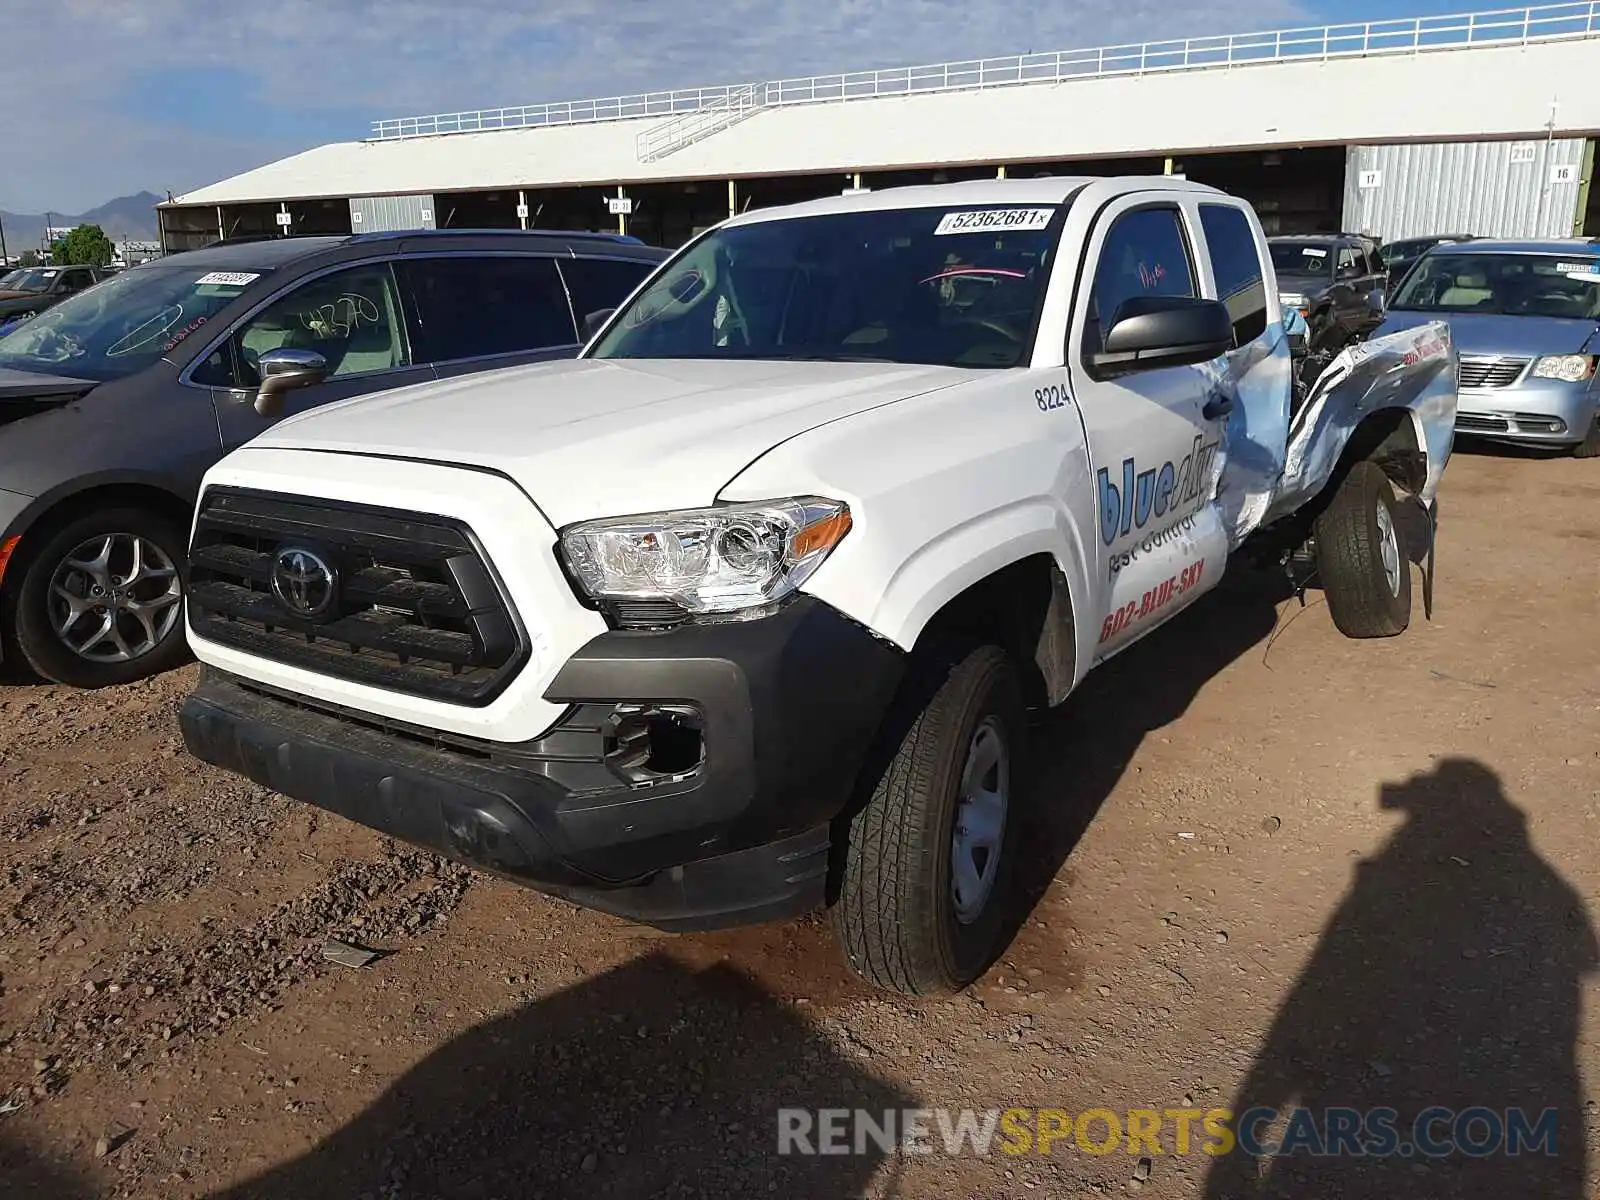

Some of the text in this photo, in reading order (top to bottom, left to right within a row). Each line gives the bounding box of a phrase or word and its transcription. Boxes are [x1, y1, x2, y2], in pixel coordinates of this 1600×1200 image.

[1367, 174, 1375, 184] 17
[1557, 168, 1569, 179] 16
[1034, 383, 1071, 411] 8224
